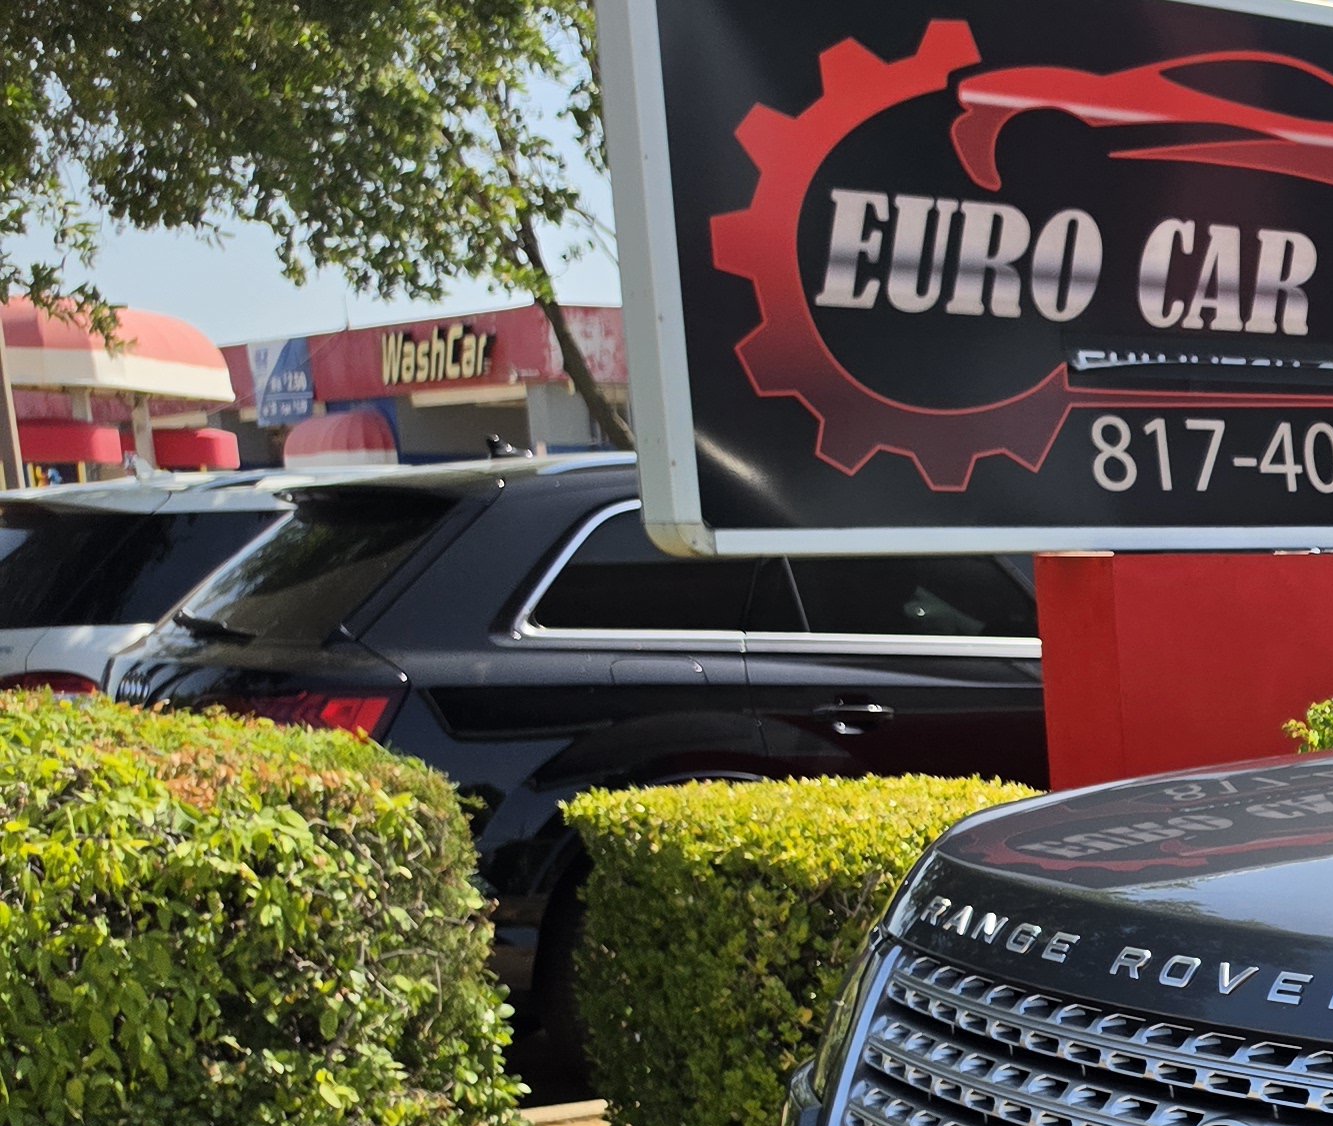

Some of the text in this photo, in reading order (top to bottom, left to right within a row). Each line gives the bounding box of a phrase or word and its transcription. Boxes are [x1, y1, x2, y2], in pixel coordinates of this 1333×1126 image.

[815, 188, 1103, 322] EURO
[1138, 217, 1318, 336] CAR
[382, 323, 488, 386] WashCar
[919, 895, 1081, 964] RANGE
